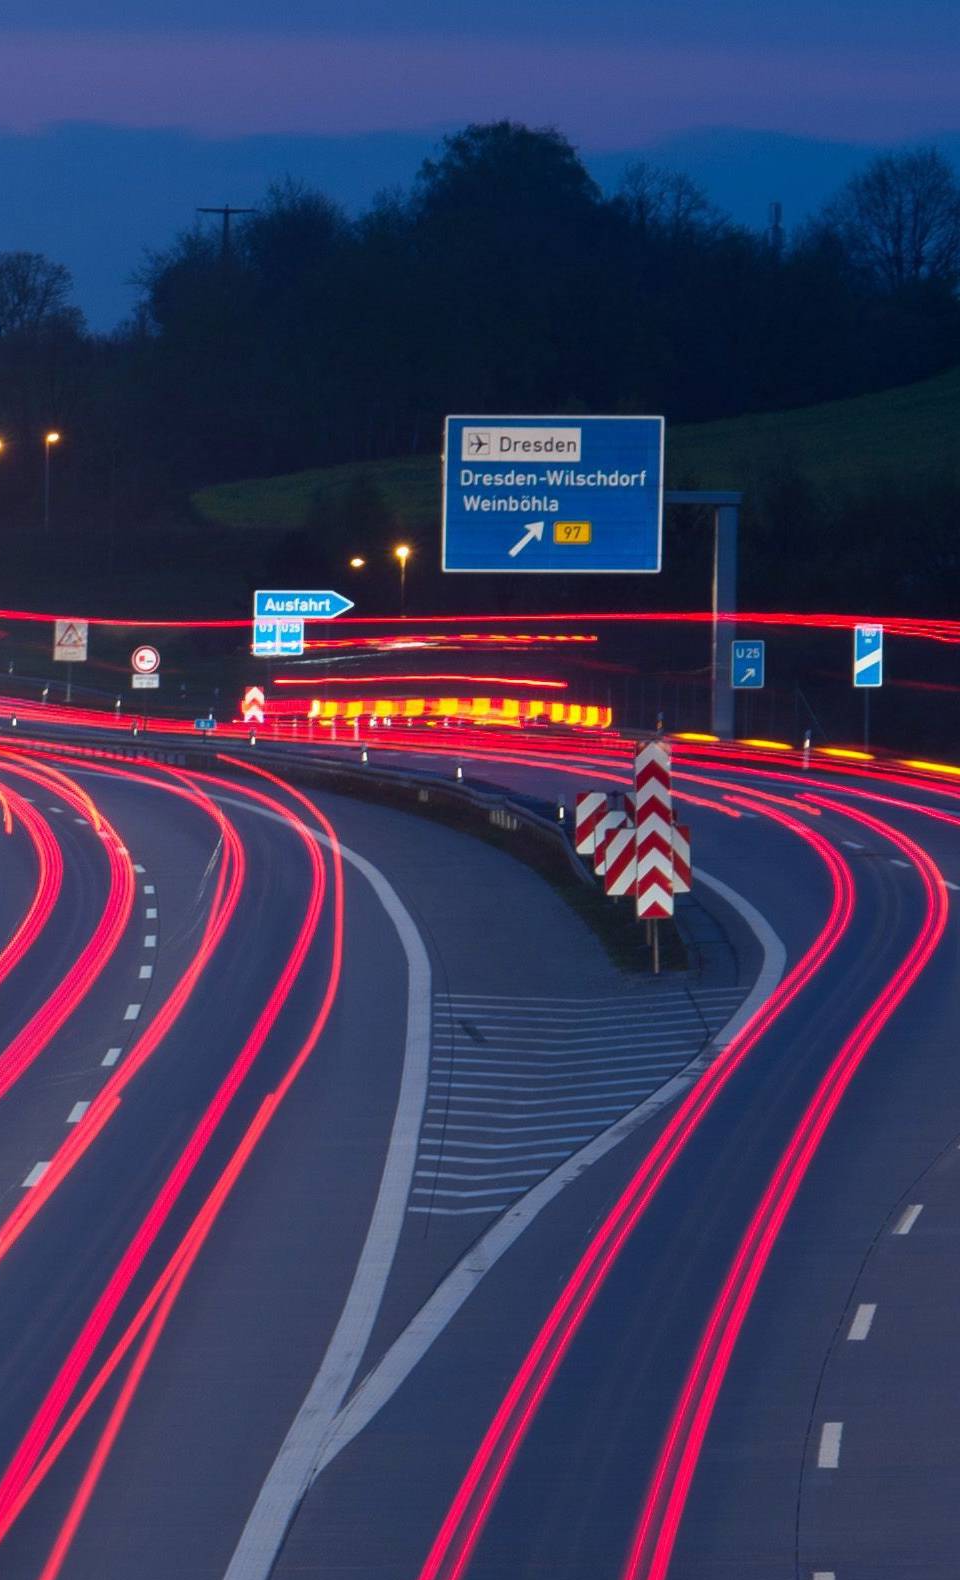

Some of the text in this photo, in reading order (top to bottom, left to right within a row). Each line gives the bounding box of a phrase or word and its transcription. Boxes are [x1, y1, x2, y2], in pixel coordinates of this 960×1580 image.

[499, 436, 577, 452] Dresden
[460, 469, 647, 486] Dresden-Wilschdorf
[463, 494, 559, 512] Weinböhla
[563, 526, 582, 540] 97
[264, 598, 330, 611] Ausfahrt
